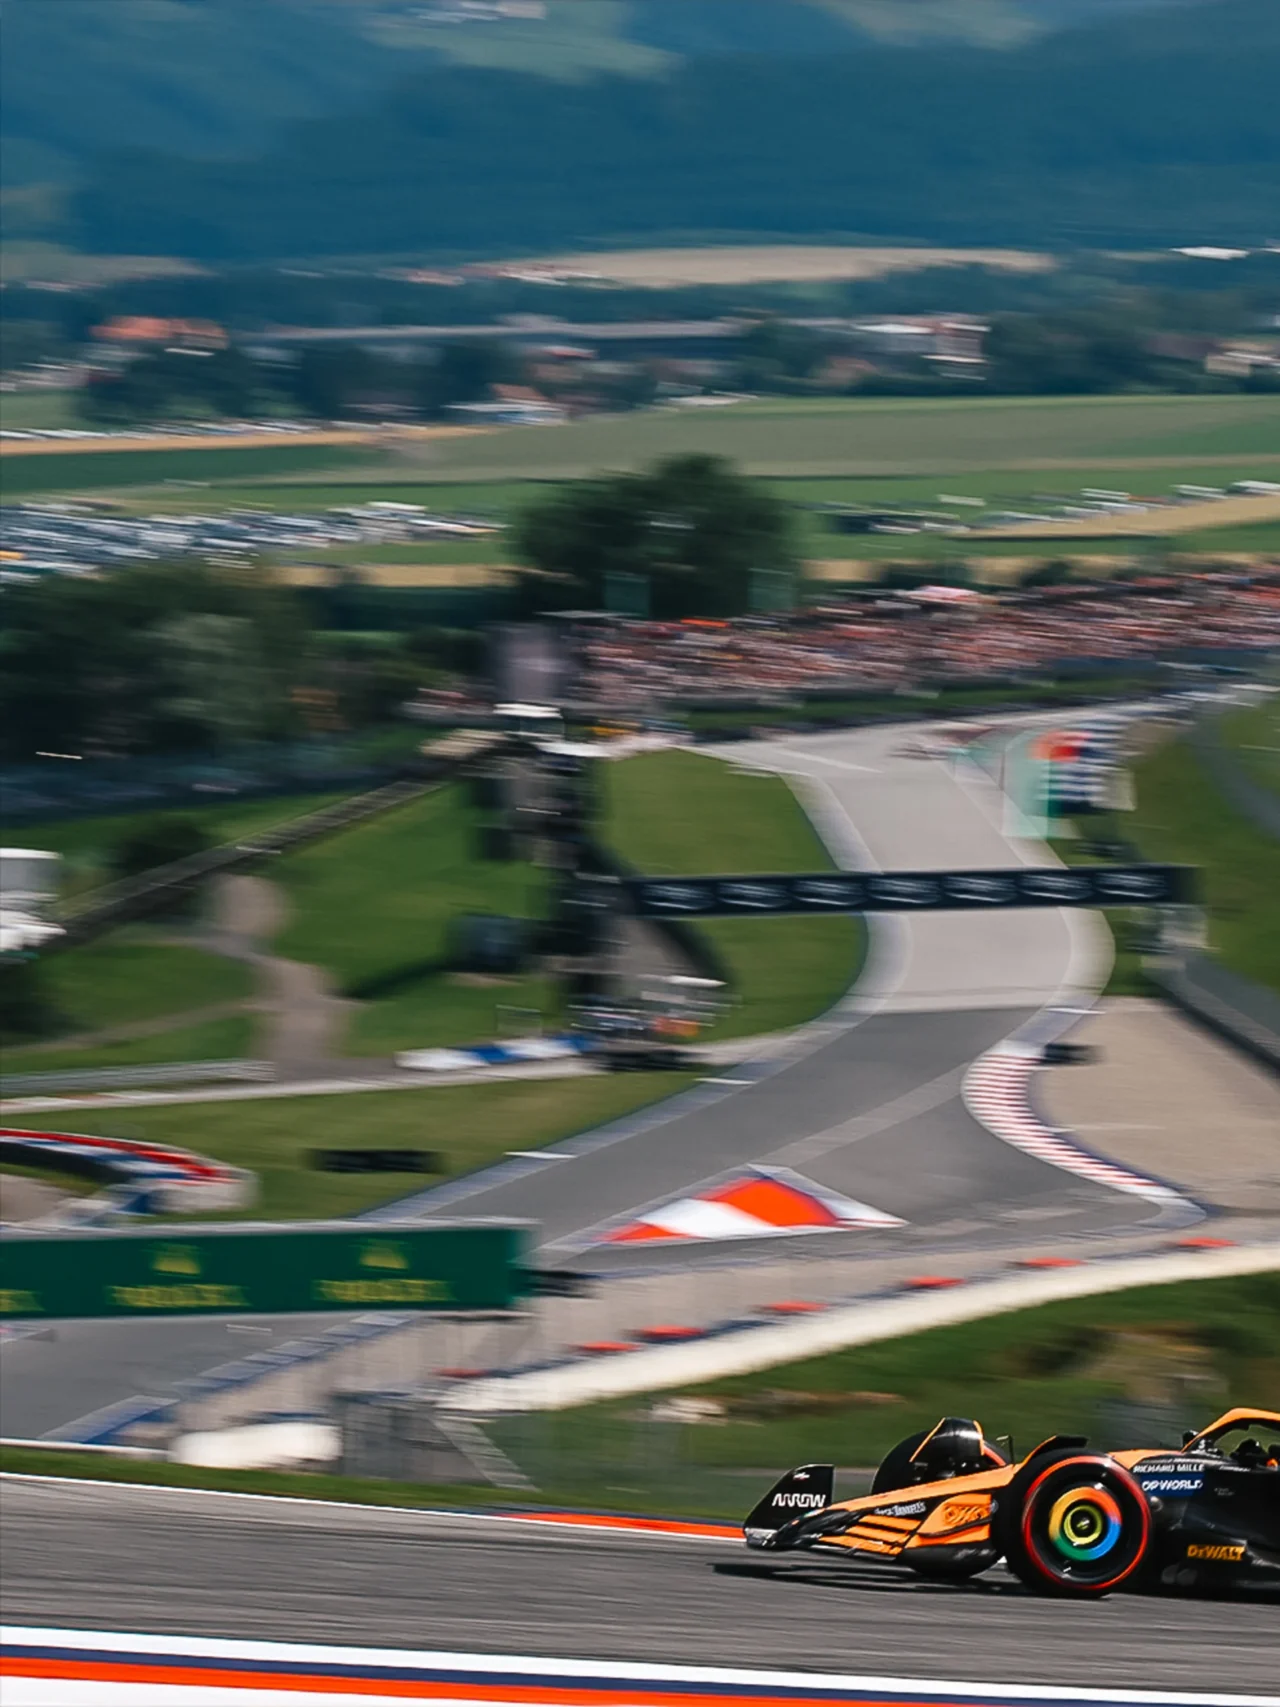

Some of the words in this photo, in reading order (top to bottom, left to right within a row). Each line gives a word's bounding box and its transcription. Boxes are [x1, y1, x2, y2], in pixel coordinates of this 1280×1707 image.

[1133, 1464, 1175, 1473] RICHARD
[1177, 1463, 1205, 1472] MILLE
[771, 1493, 826, 1508] ARROW
